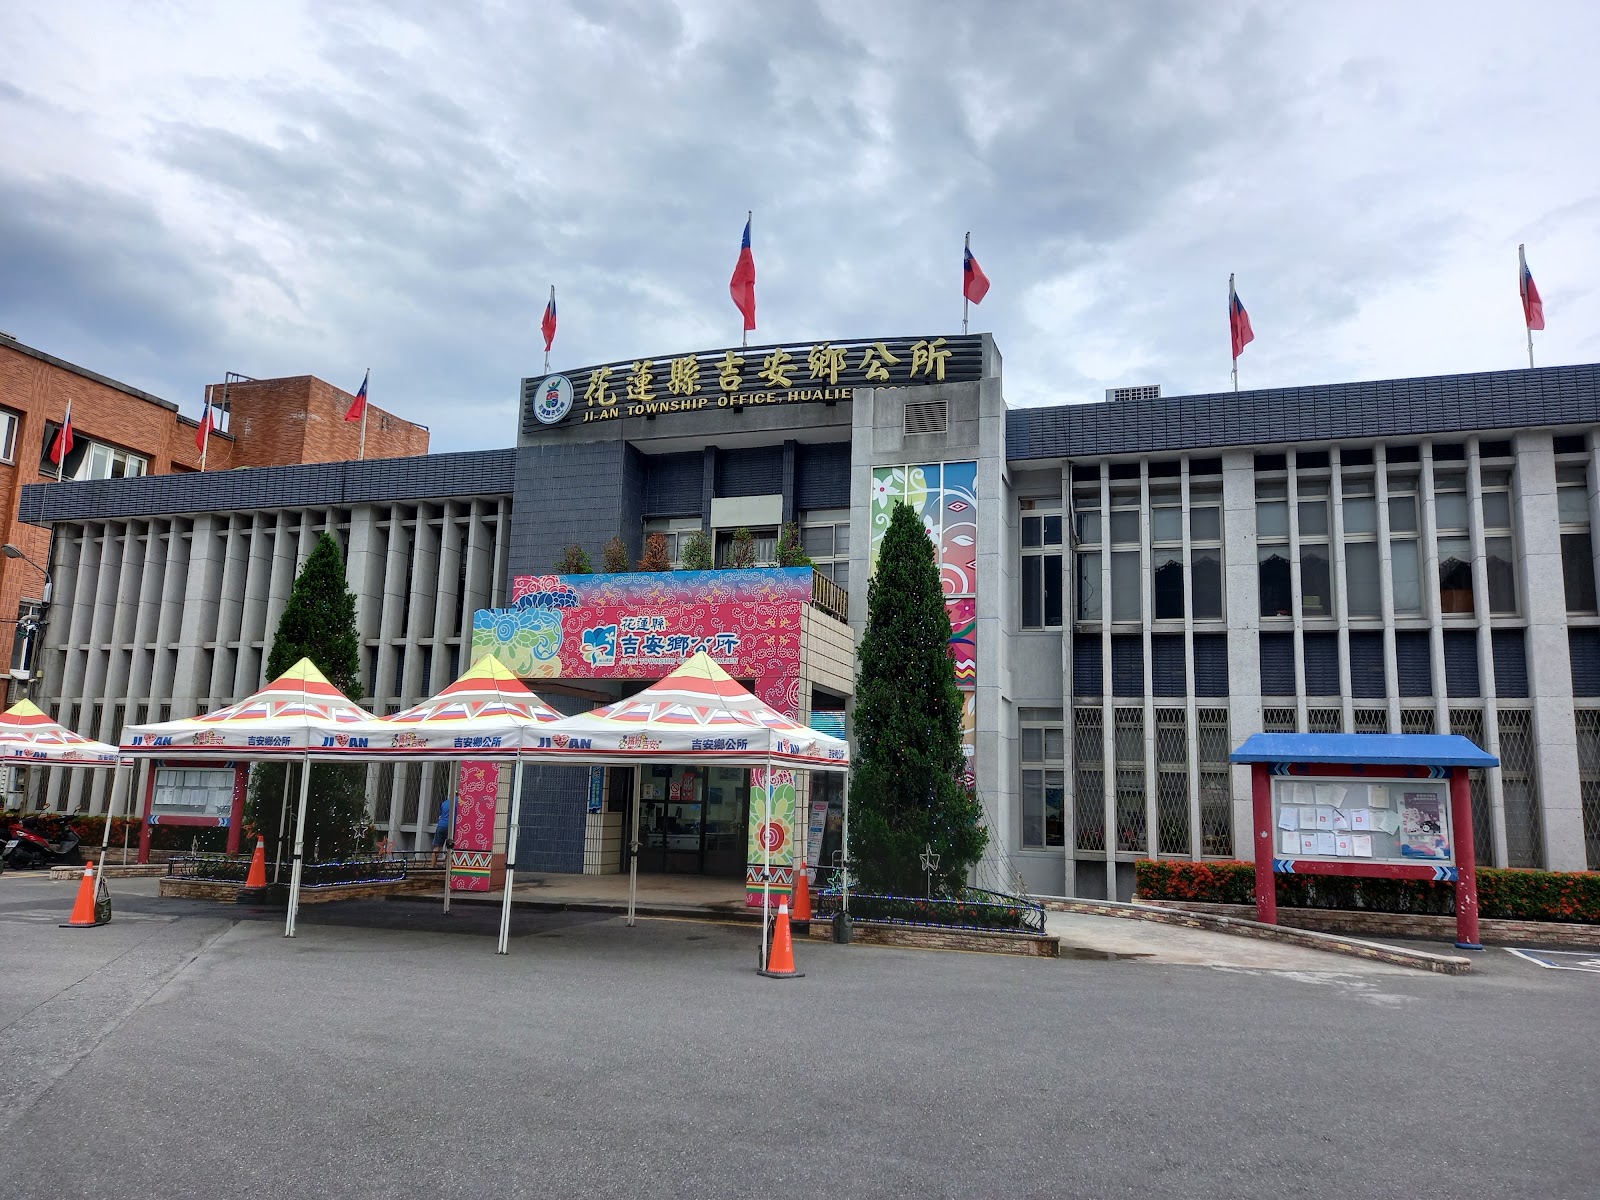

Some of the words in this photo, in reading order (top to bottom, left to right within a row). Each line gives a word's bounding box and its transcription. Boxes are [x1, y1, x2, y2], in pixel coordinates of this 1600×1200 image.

[583, 337, 953, 408] 花蓮縣吉安鄉公所
[583, 407, 619, 423] JI-AN
[627, 397, 709, 416] TOWNSHIP
[717, 391, 783, 408] OFFICE,
[787, 387, 852, 403] HUALIE
[620, 616, 667, 632] 花蓮縣
[619, 633, 740, 657] 吉安鄉公所
[131, 736, 143, 746] JI
[154, 736, 173, 746] AN
[247, 735, 291, 746] 吉安鄉公所
[322, 736, 335, 747] JI
[349, 737, 369, 748] AN
[453, 736, 502, 748] 吉安鄉公所
[537, 737, 551, 748] JI
[568, 738, 593, 749] AN
[691, 738, 748, 750] 吉安鄉公所
